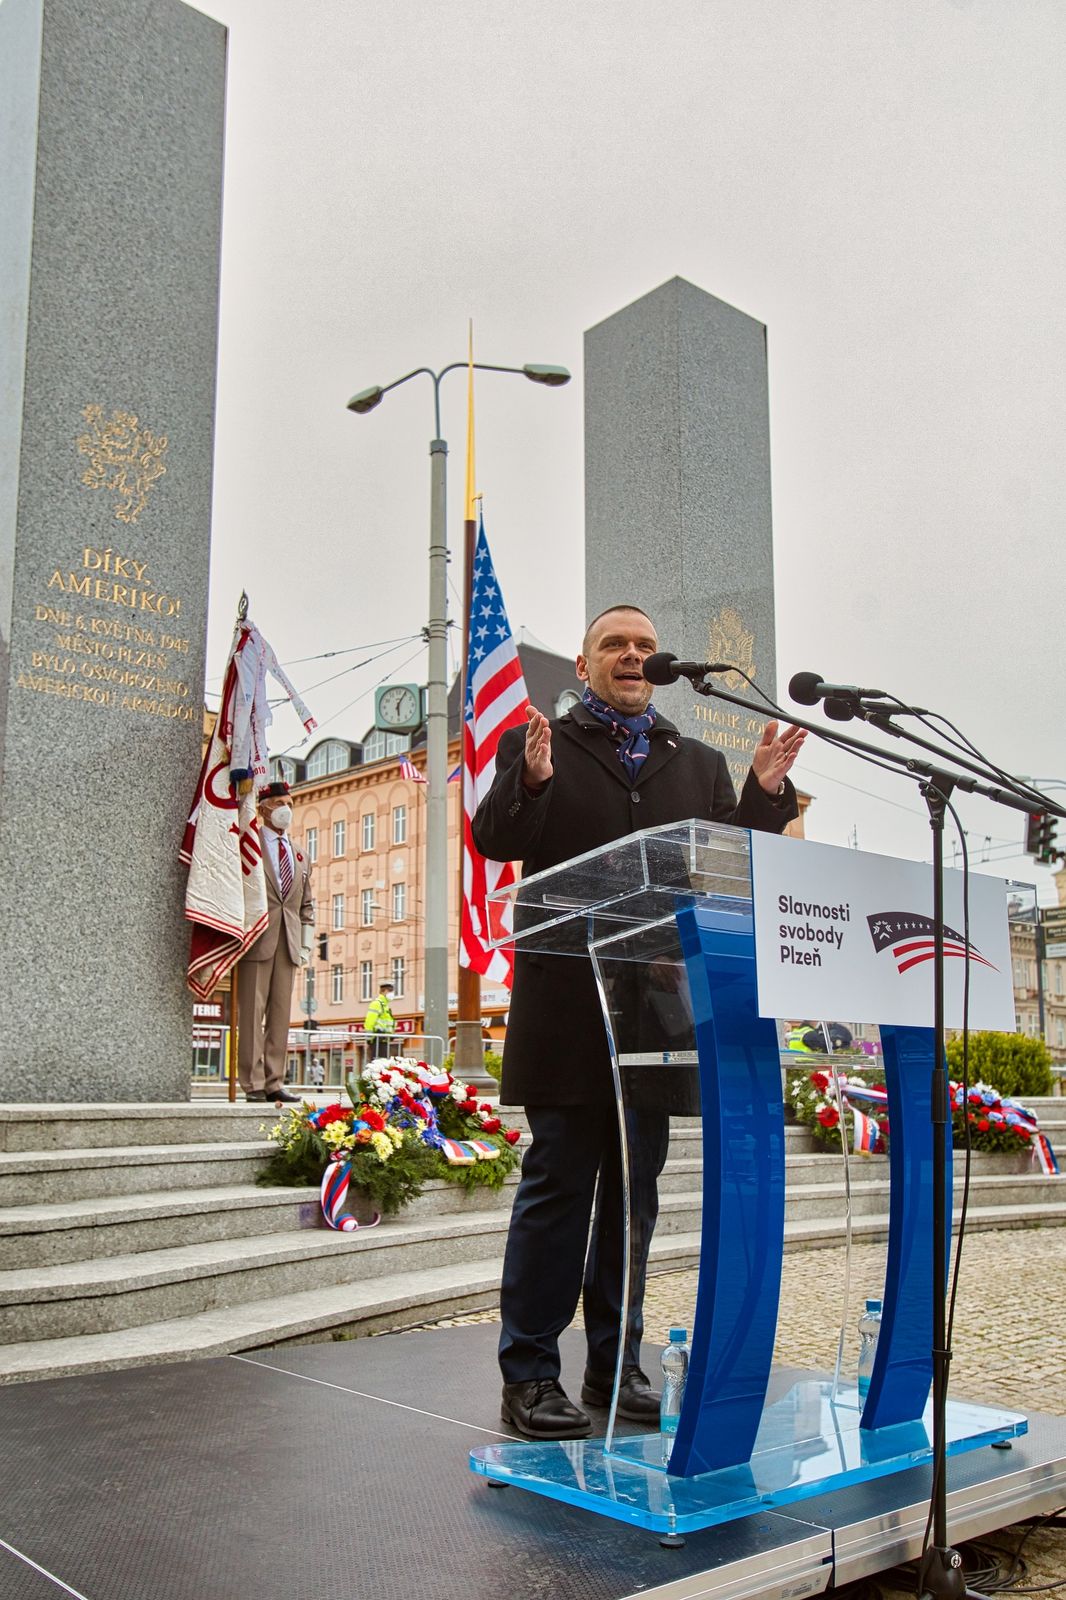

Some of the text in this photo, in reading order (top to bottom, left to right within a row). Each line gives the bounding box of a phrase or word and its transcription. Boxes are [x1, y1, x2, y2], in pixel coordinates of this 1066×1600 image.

[82, 547, 151, 586] DÍKY,
[47, 569, 181, 618] AMERIKO!
[35, 605, 190, 655] DNE 6. KVĚTNA 1945
[56, 632, 168, 669] MĚSTO PLZEŇ
[32, 651, 188, 698] BYLO OSVOBOZENO
[17, 675, 199, 722] AMERICKOU ARMÁDOU
[693, 704, 740, 730] THANK
[778, 894, 850, 922] Slavnosti
[779, 922, 844, 950] svobody
[780, 945, 822, 967] Plzeň
